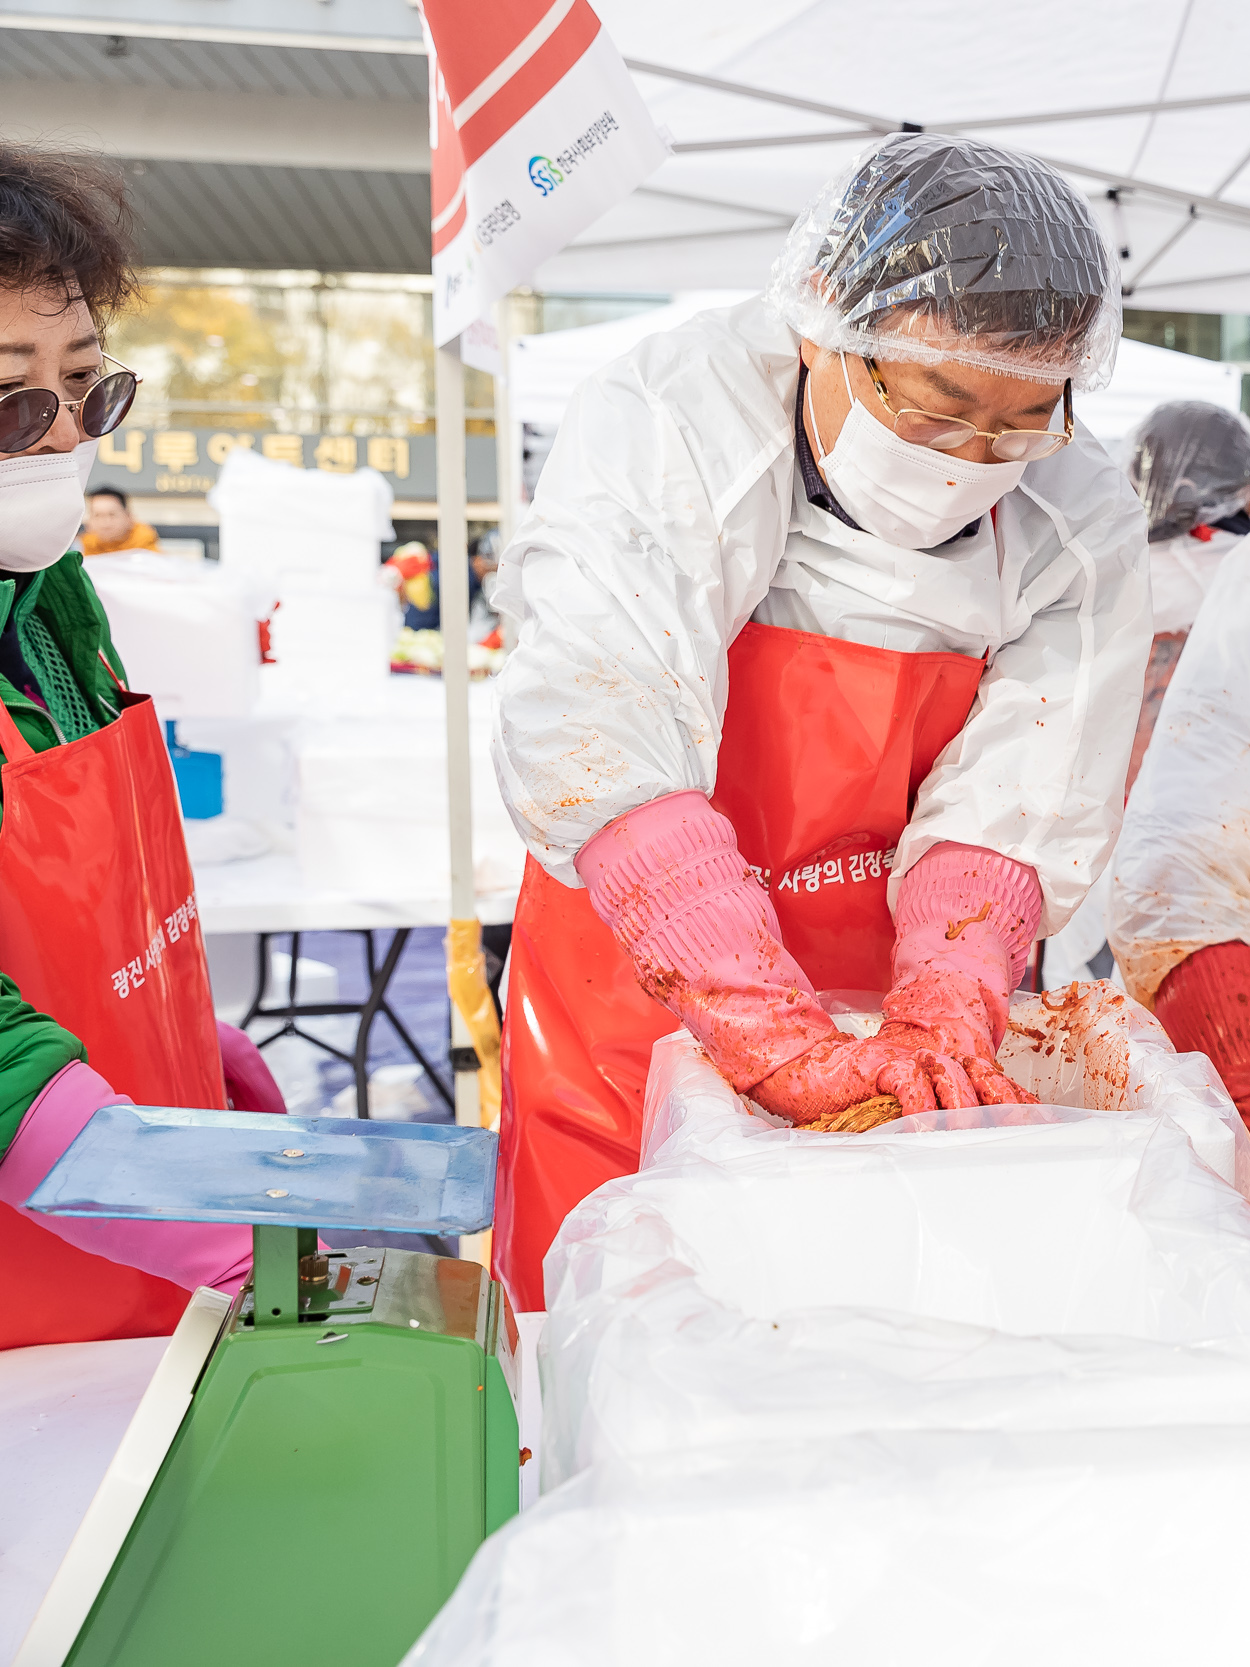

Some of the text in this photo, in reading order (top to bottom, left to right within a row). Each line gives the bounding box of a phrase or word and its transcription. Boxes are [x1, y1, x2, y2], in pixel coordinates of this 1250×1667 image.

[777, 858, 845, 893] 사랑의
[111, 956, 146, 999] 광진
[145, 924, 166, 971] 사랑의
